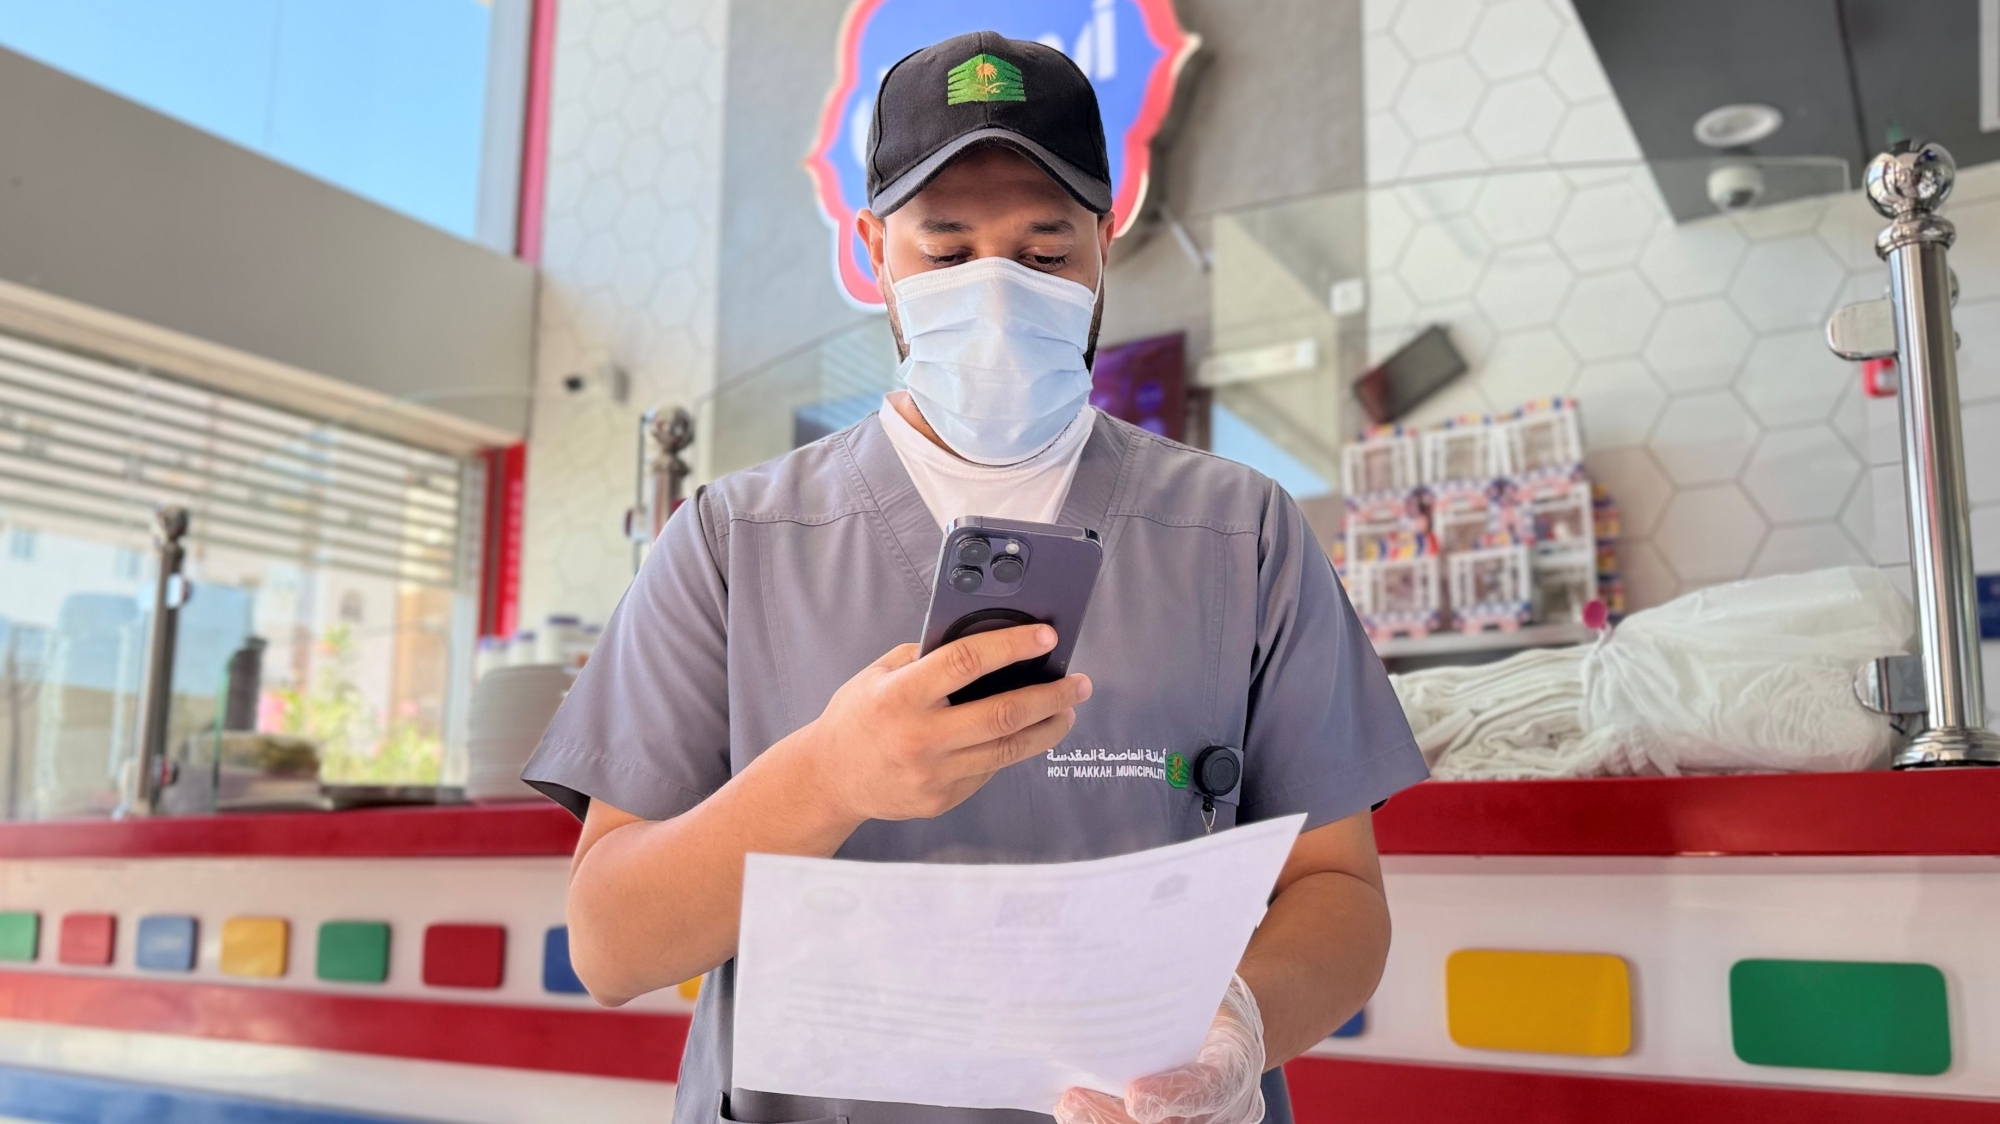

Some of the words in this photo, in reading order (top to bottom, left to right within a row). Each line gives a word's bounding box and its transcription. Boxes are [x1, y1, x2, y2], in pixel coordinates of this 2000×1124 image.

[1046, 748, 1097, 762] المقدسة
[1097, 748, 1144, 762] العاصمة
[1145, 748, 1167, 764] أمانة
[1047, 766, 1070, 778] HOLY
[1073, 765, 1112, 778] MAKKAH
